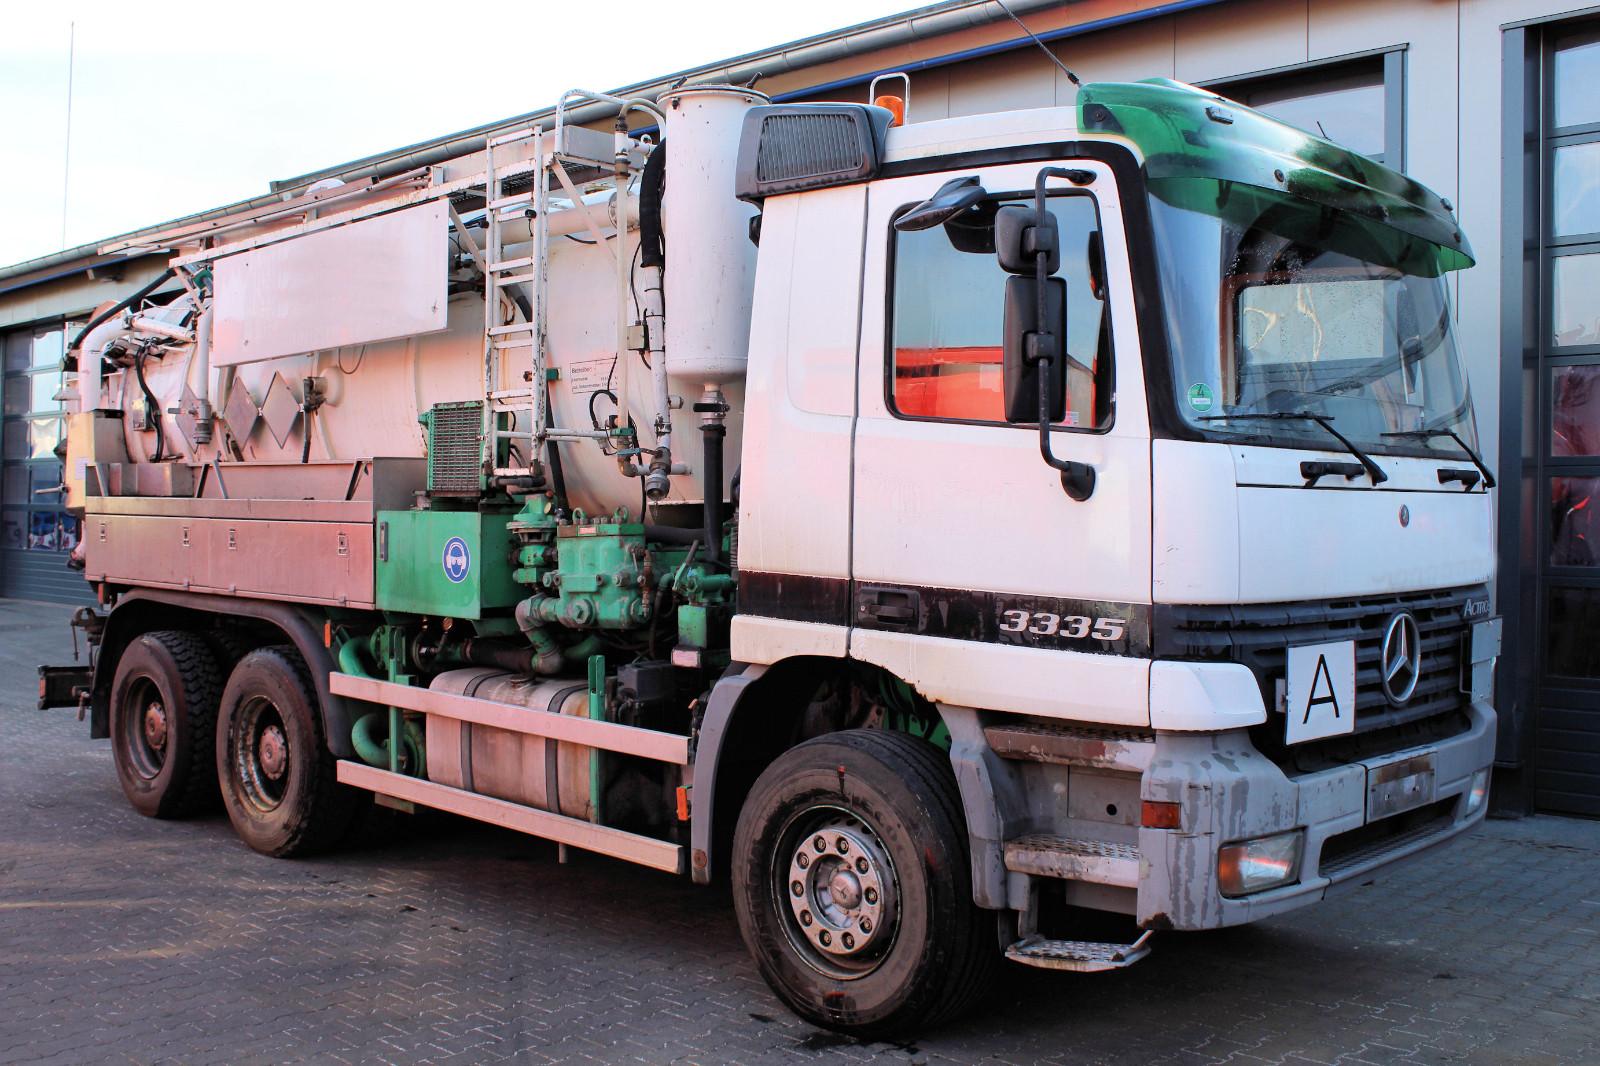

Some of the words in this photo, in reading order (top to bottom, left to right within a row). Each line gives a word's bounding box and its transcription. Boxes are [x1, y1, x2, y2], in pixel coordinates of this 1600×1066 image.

[1197, 384, 1205, 398] 4
[999, 610, 1126, 640] 3335
[1302, 654, 1340, 724] A
